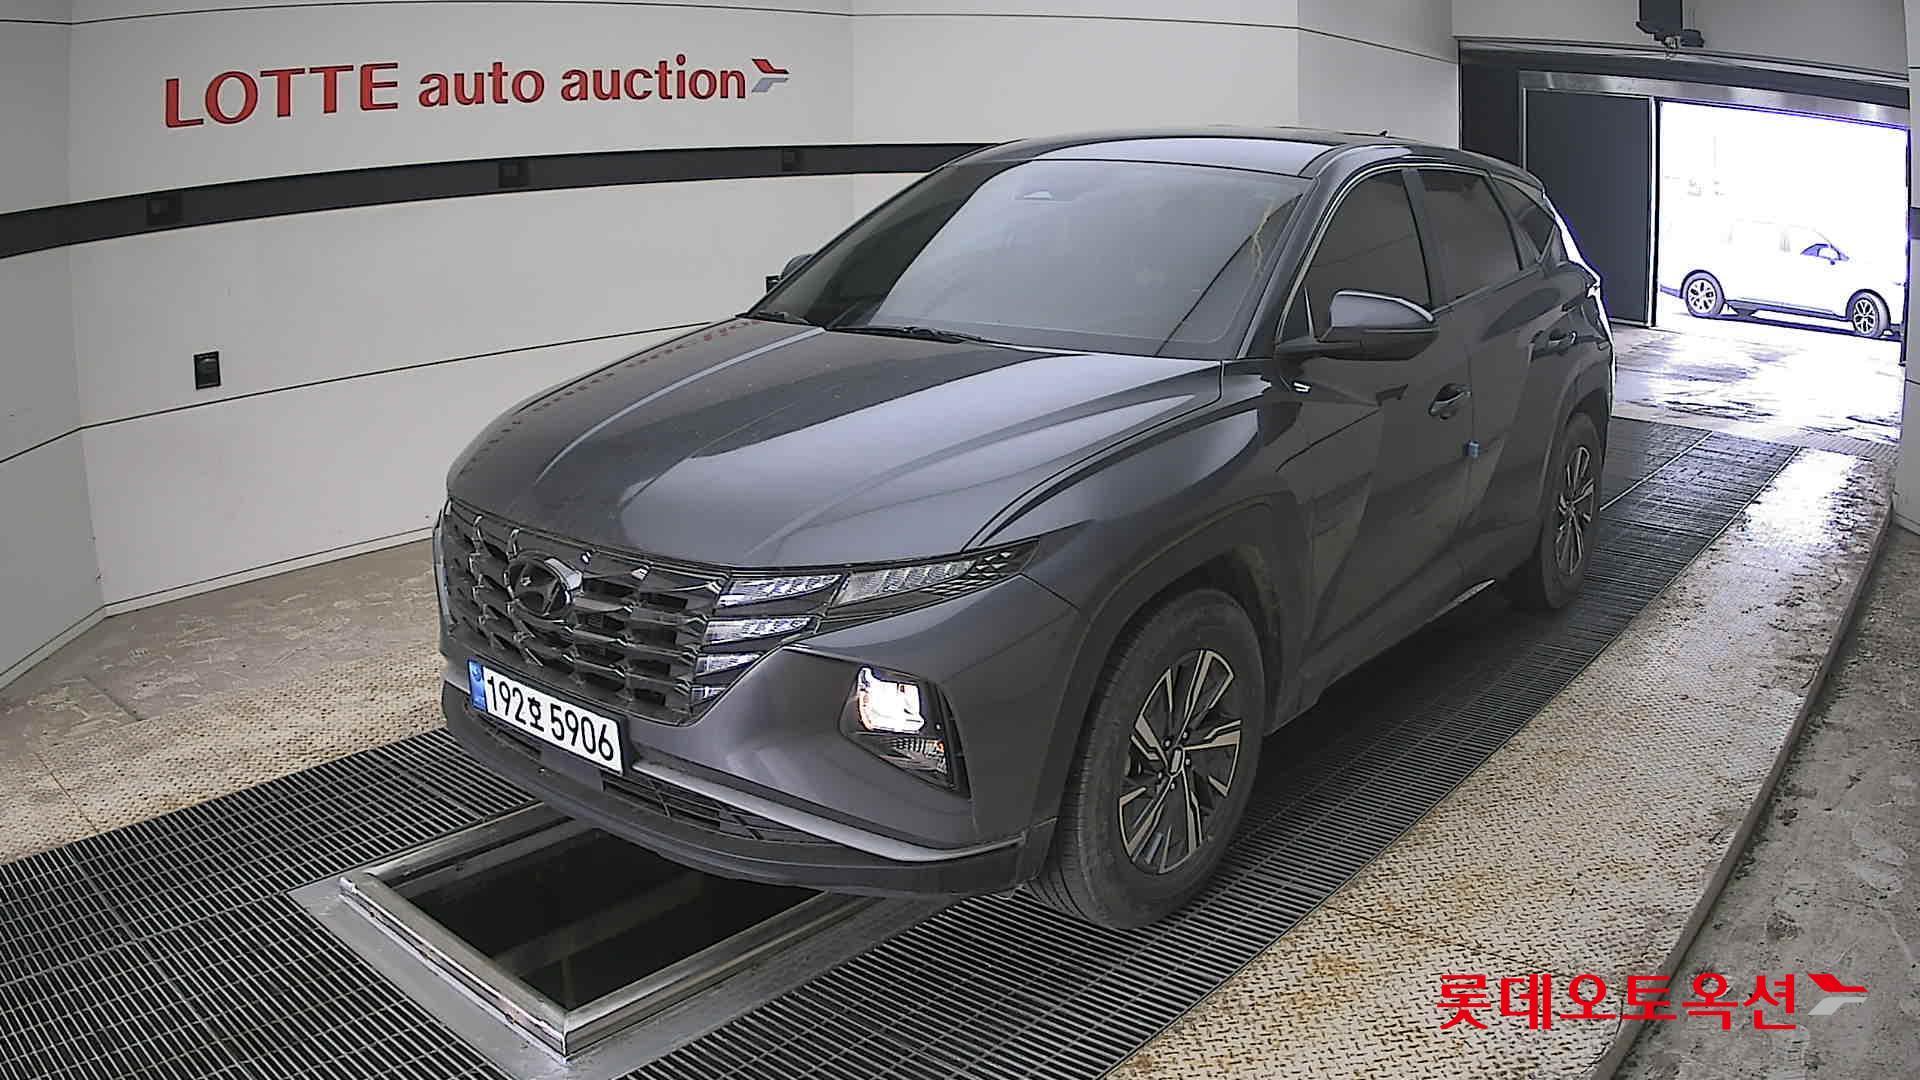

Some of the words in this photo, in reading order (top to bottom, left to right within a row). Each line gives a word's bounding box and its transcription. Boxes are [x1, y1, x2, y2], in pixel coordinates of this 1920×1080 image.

[163, 61, 400, 129] LOTTE
[418, 61, 546, 108] auto
[560, 54, 747, 101] auction
[549, 702, 615, 762] 5906
